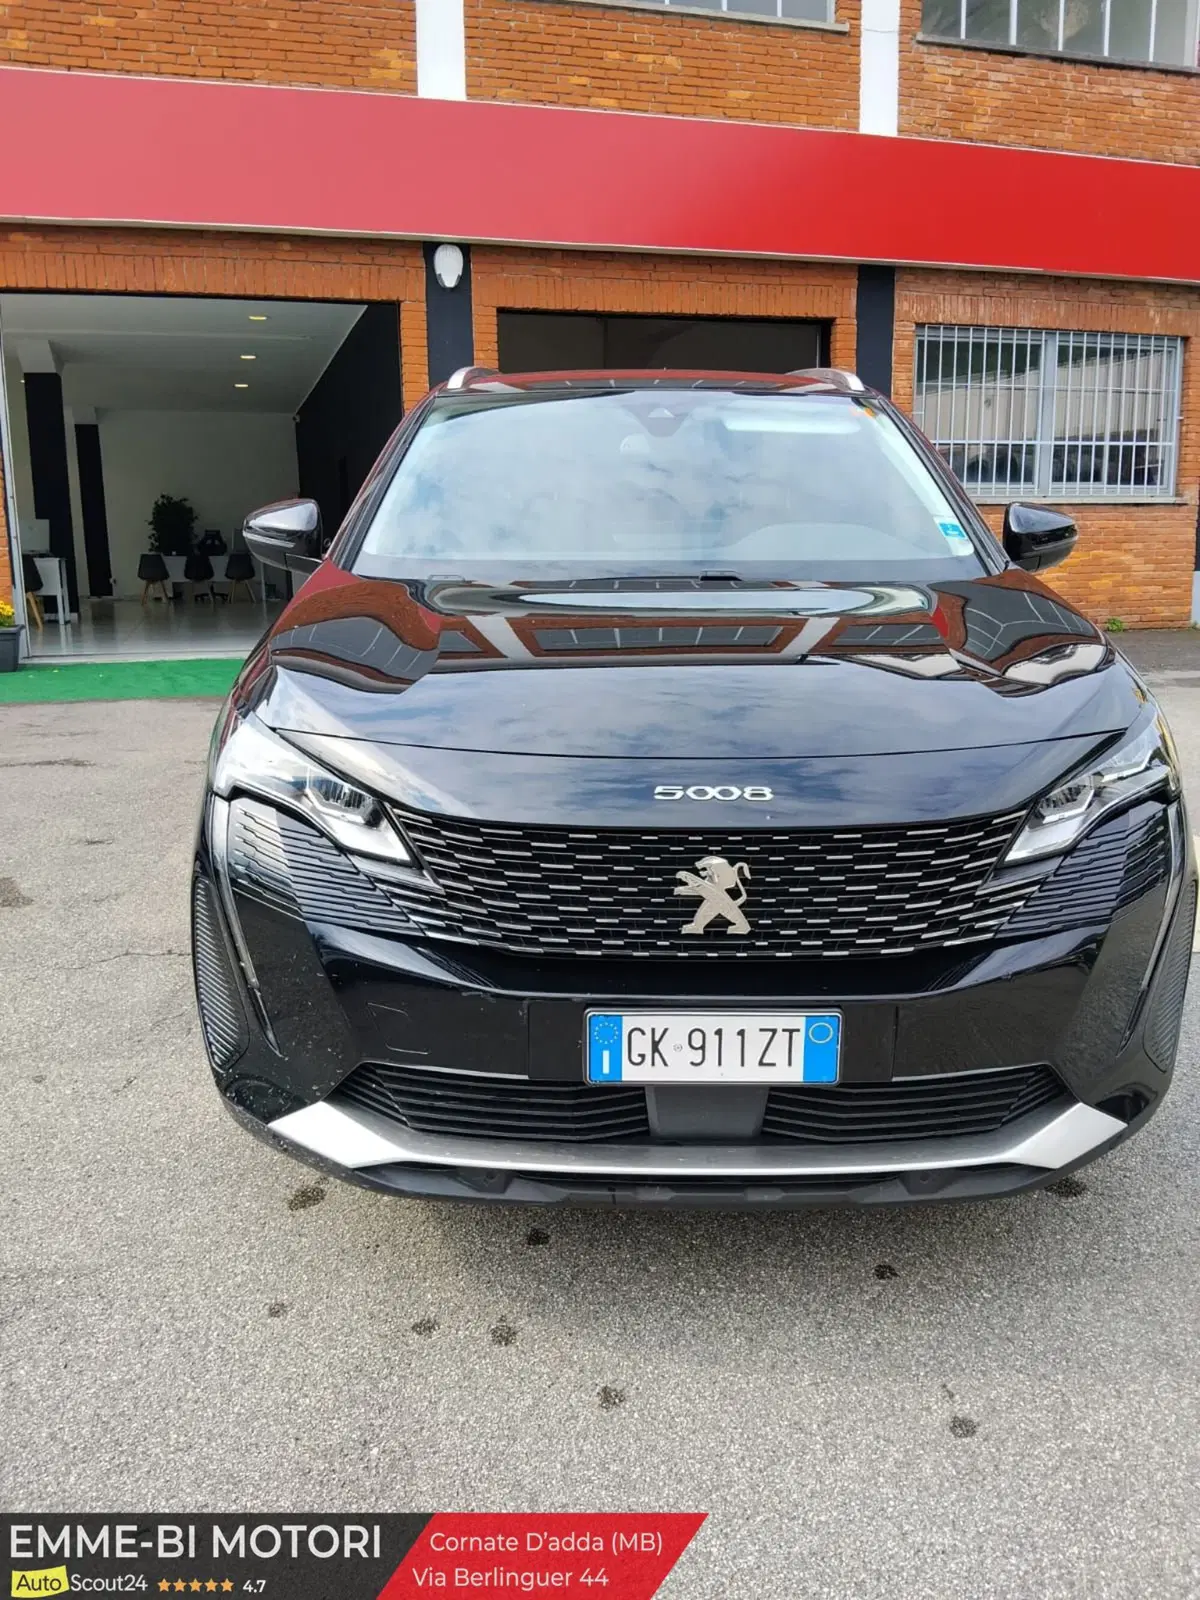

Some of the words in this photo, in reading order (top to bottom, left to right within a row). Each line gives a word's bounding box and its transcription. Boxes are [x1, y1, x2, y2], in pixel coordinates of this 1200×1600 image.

[653, 785, 775, 801] 5008
[626, 1026, 670, 1068] GK
[687, 1027, 801, 1068] 911ZT
[602, 1050, 610, 1074] I
